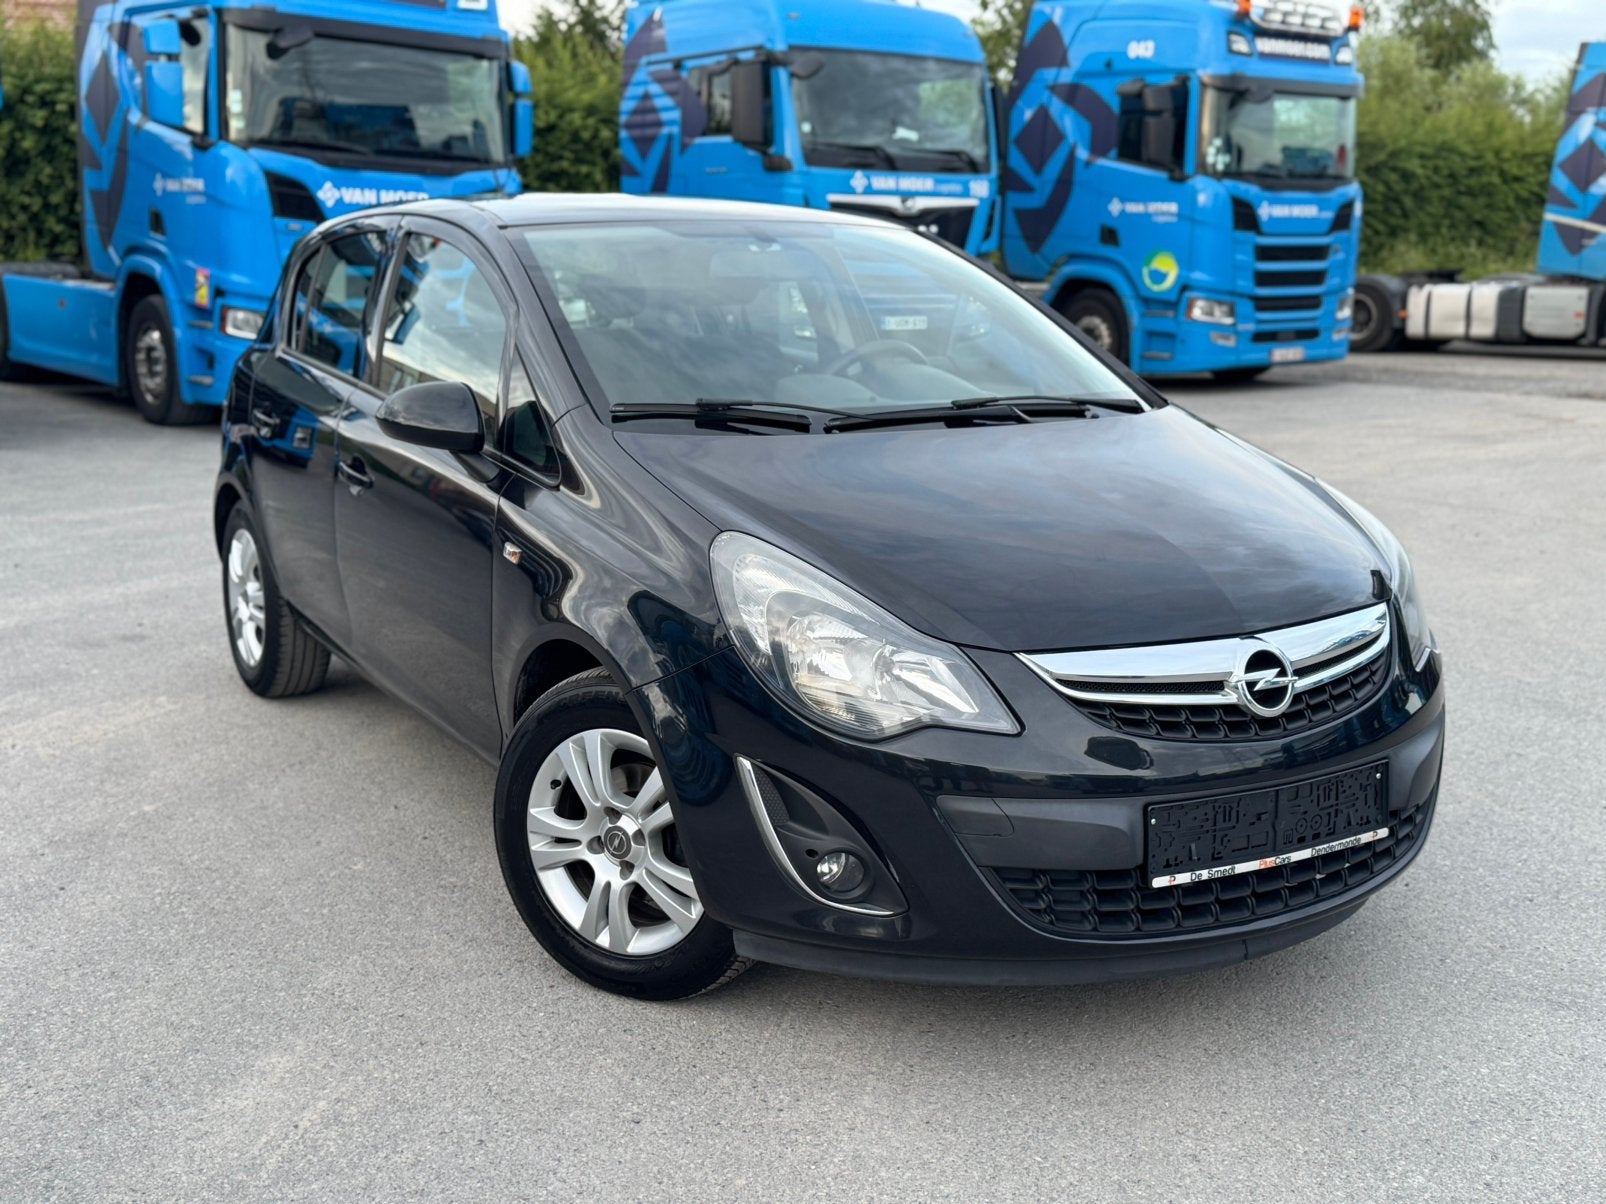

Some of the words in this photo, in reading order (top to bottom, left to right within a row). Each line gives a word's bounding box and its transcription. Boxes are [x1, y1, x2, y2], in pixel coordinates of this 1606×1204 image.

[340, 187, 377, 205] VAN
[1190, 872, 1202, 882] De
[1310, 836, 1362, 857] Dendermonde
